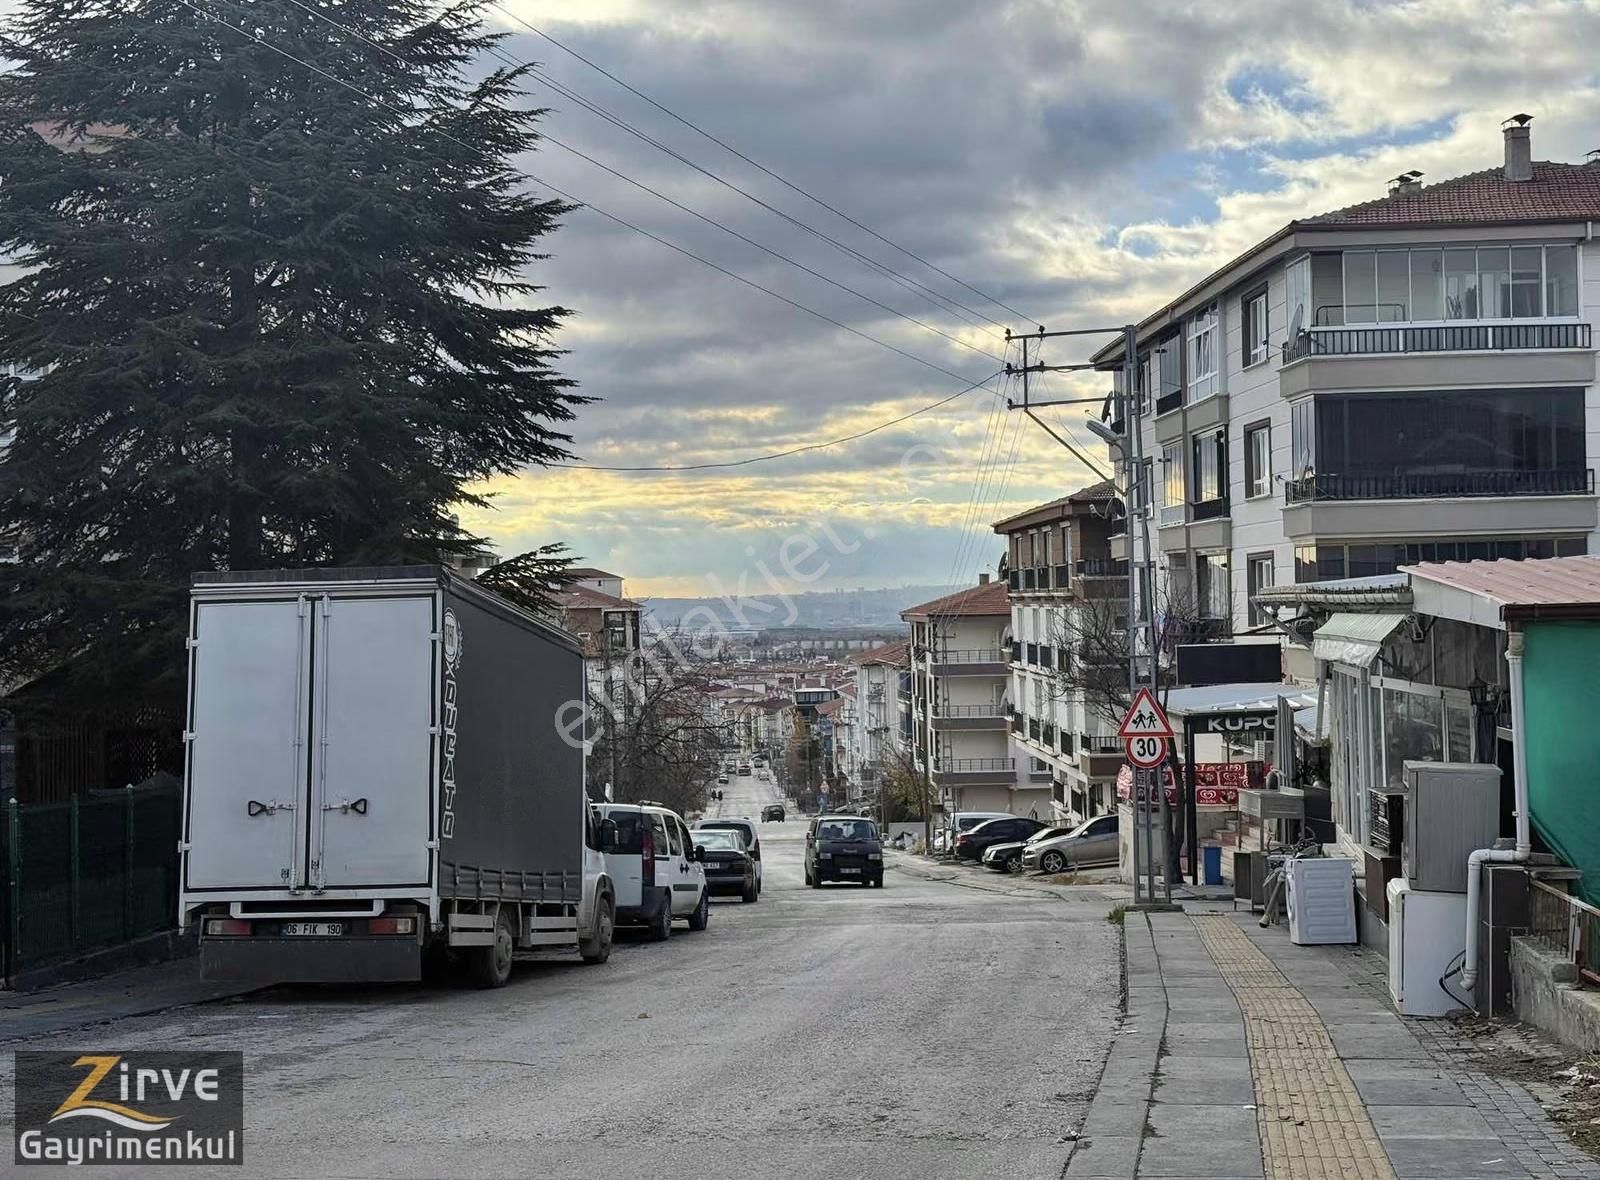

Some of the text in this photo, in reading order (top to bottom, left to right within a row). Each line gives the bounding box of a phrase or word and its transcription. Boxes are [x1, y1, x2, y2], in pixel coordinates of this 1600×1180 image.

[1137, 738, 1157, 757] 30
[442, 679, 458, 838] DUCATO
[303, 923, 318, 935] FIK
[327, 923, 341, 935] 190
